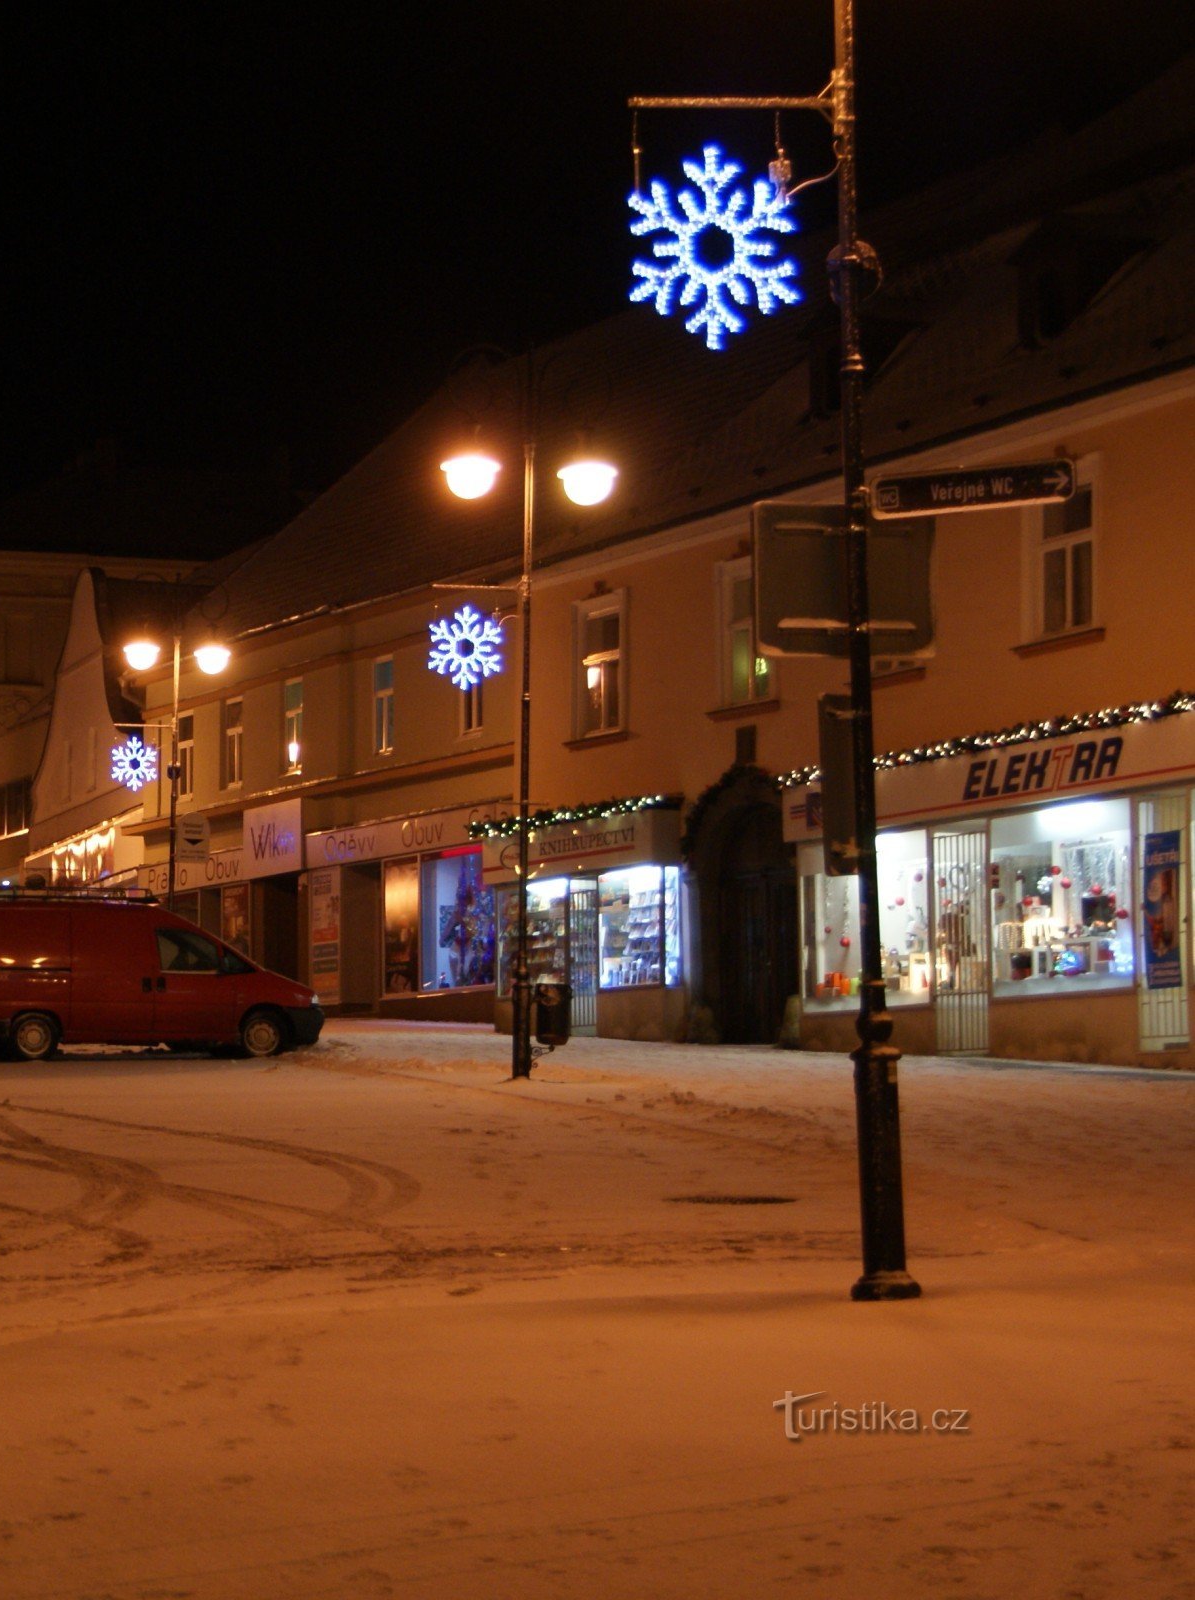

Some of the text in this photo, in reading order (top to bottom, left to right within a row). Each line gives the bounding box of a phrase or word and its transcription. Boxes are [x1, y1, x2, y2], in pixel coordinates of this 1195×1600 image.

[930, 480, 985, 503] Veřejné
[990, 476, 1014, 496] WC
[962, 736, 1124, 801] ELEKTRA
[401, 819, 444, 848] Obuv
[148, 857, 240, 890] Prálo Obuv
